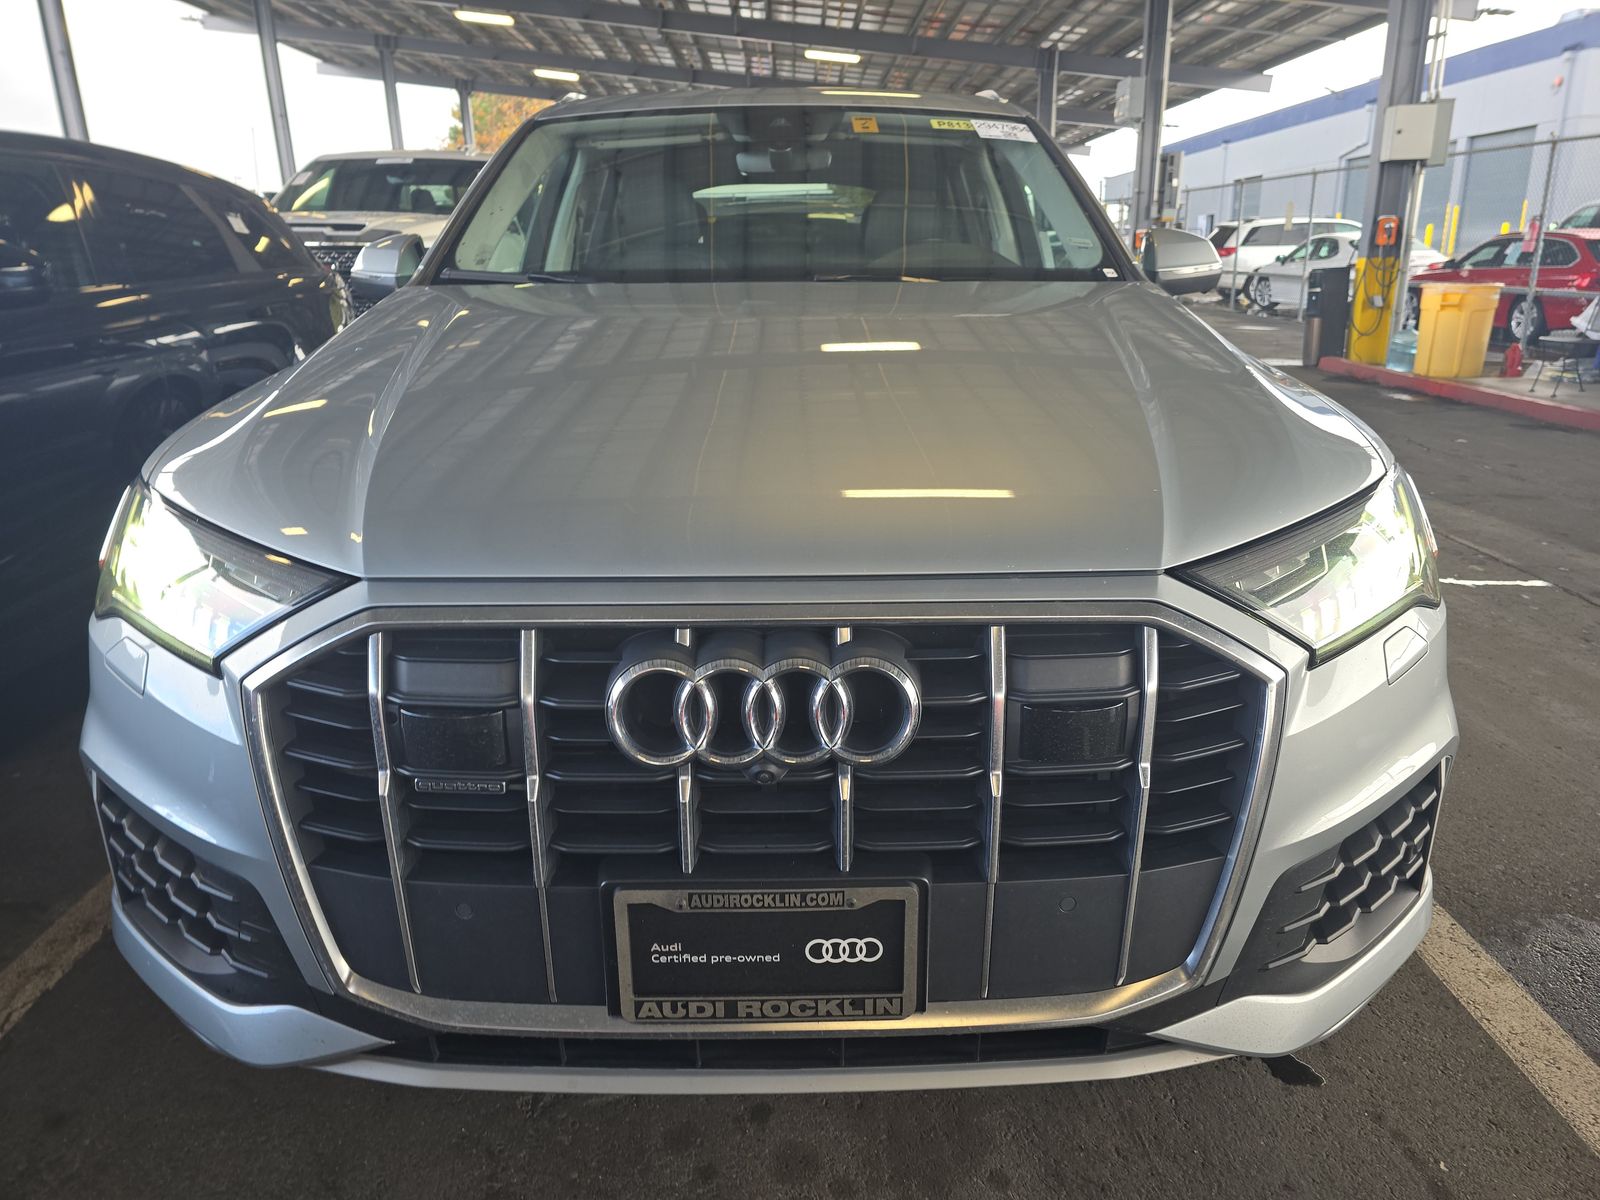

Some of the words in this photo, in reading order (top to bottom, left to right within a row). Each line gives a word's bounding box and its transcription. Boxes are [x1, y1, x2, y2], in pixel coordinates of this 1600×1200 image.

[418, 781, 501, 793] quattro
[690, 891, 844, 910] AUDIROCKLIN.COM
[650, 942, 682, 953] Audi
[651, 952, 707, 964] Certified
[711, 952, 780, 965] pre-owned
[637, 1000, 725, 1020] AUDI
[737, 997, 903, 1019] ROCKLIN
